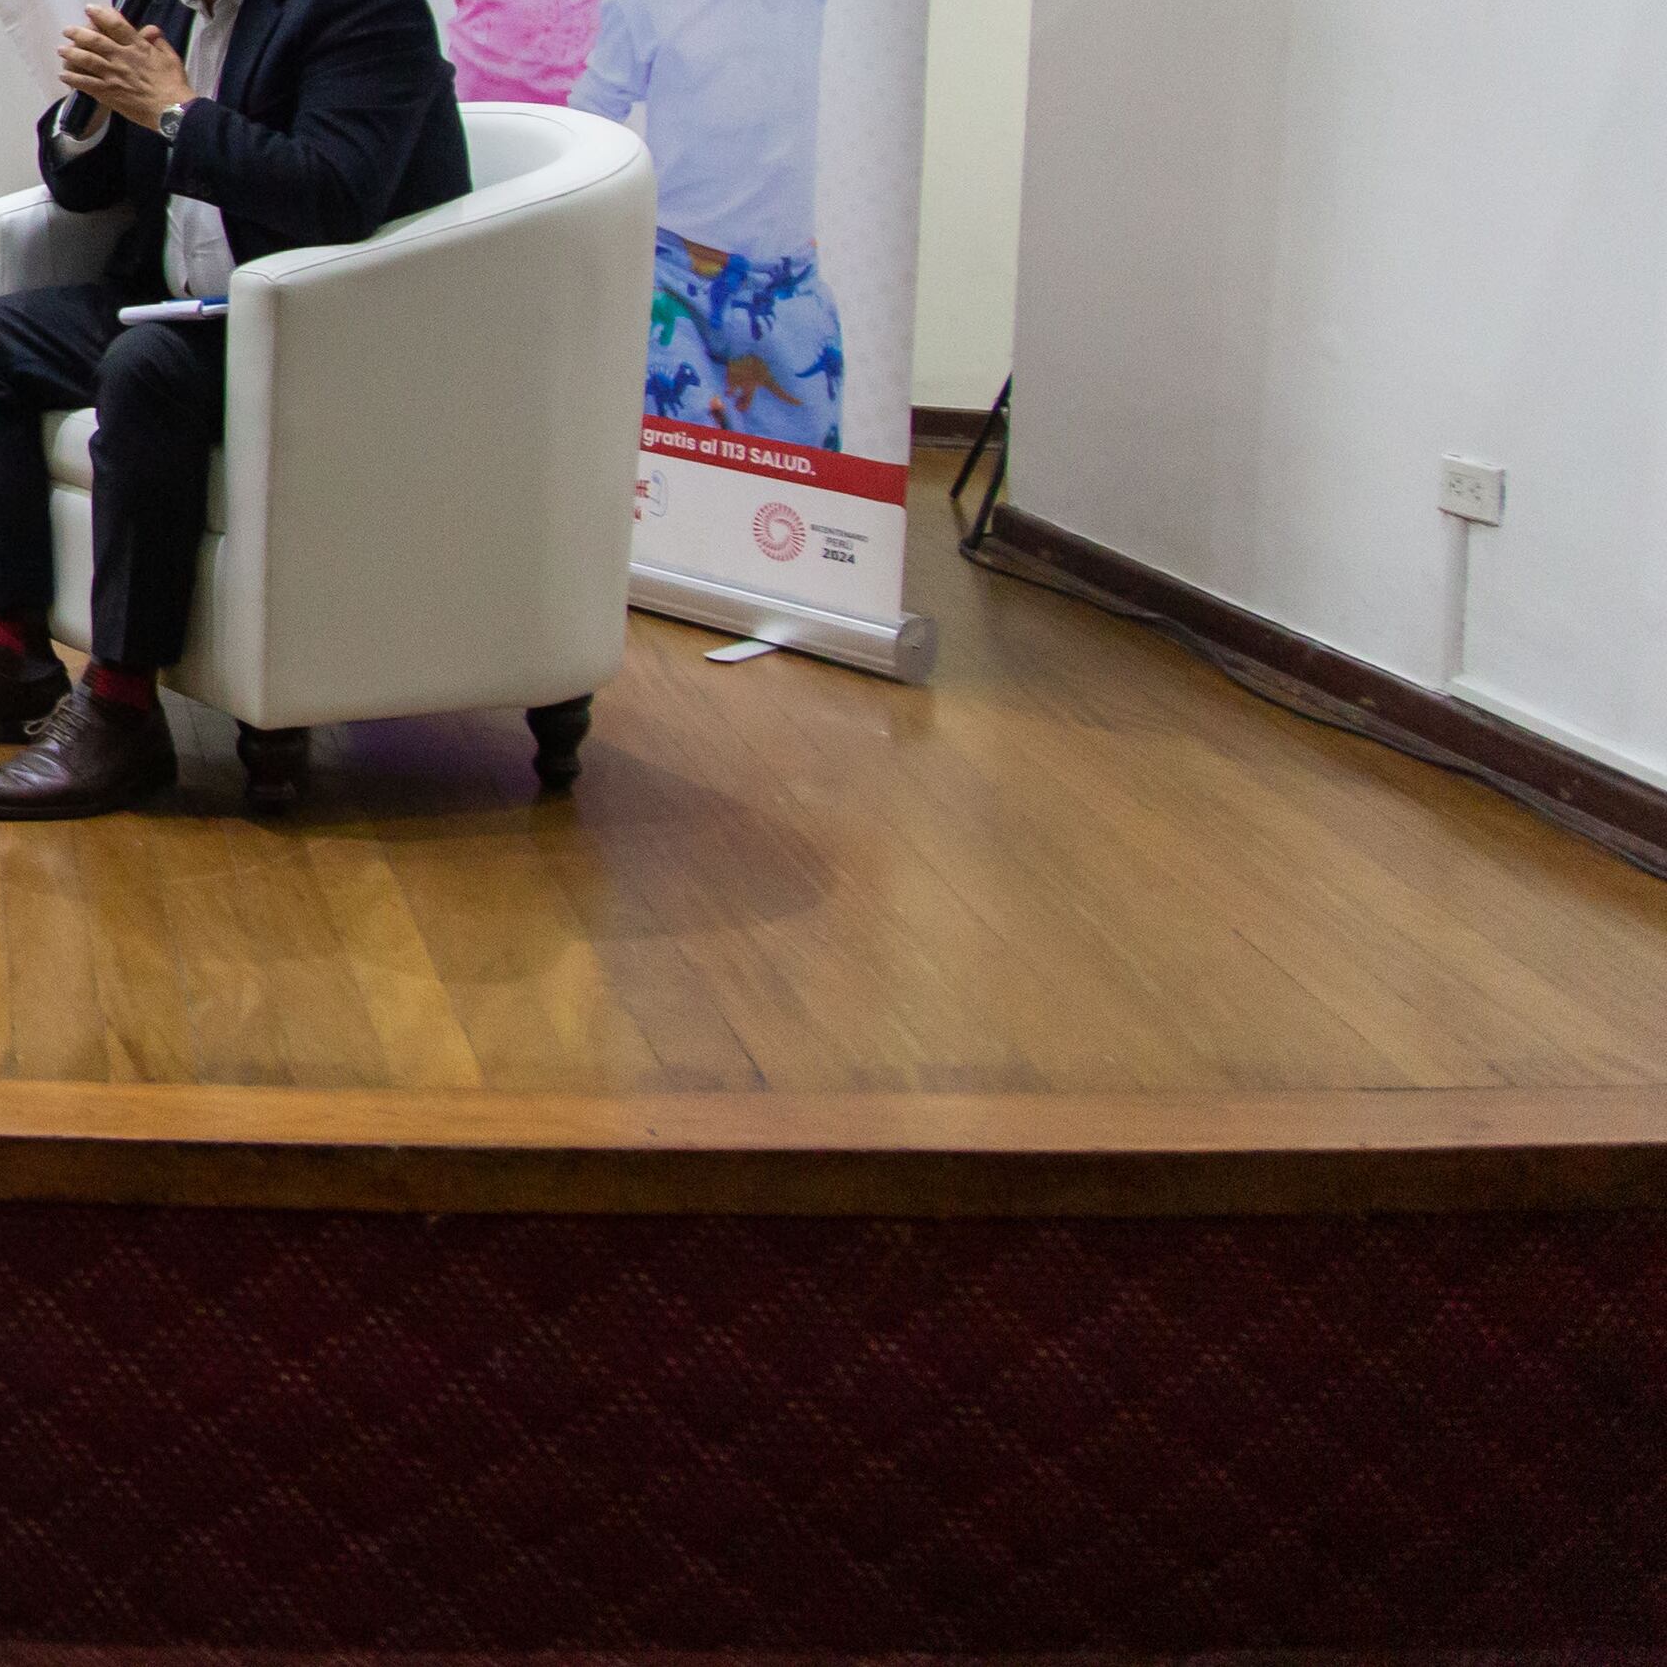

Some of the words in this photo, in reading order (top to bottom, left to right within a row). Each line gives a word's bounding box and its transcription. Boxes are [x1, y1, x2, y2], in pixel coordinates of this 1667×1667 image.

[642, 429, 695, 450] gratis
[700, 439, 717, 456] al
[721, 441, 745, 460] 113
[749, 447, 816, 475] SALUD.
[821, 547, 856, 565] 2024
